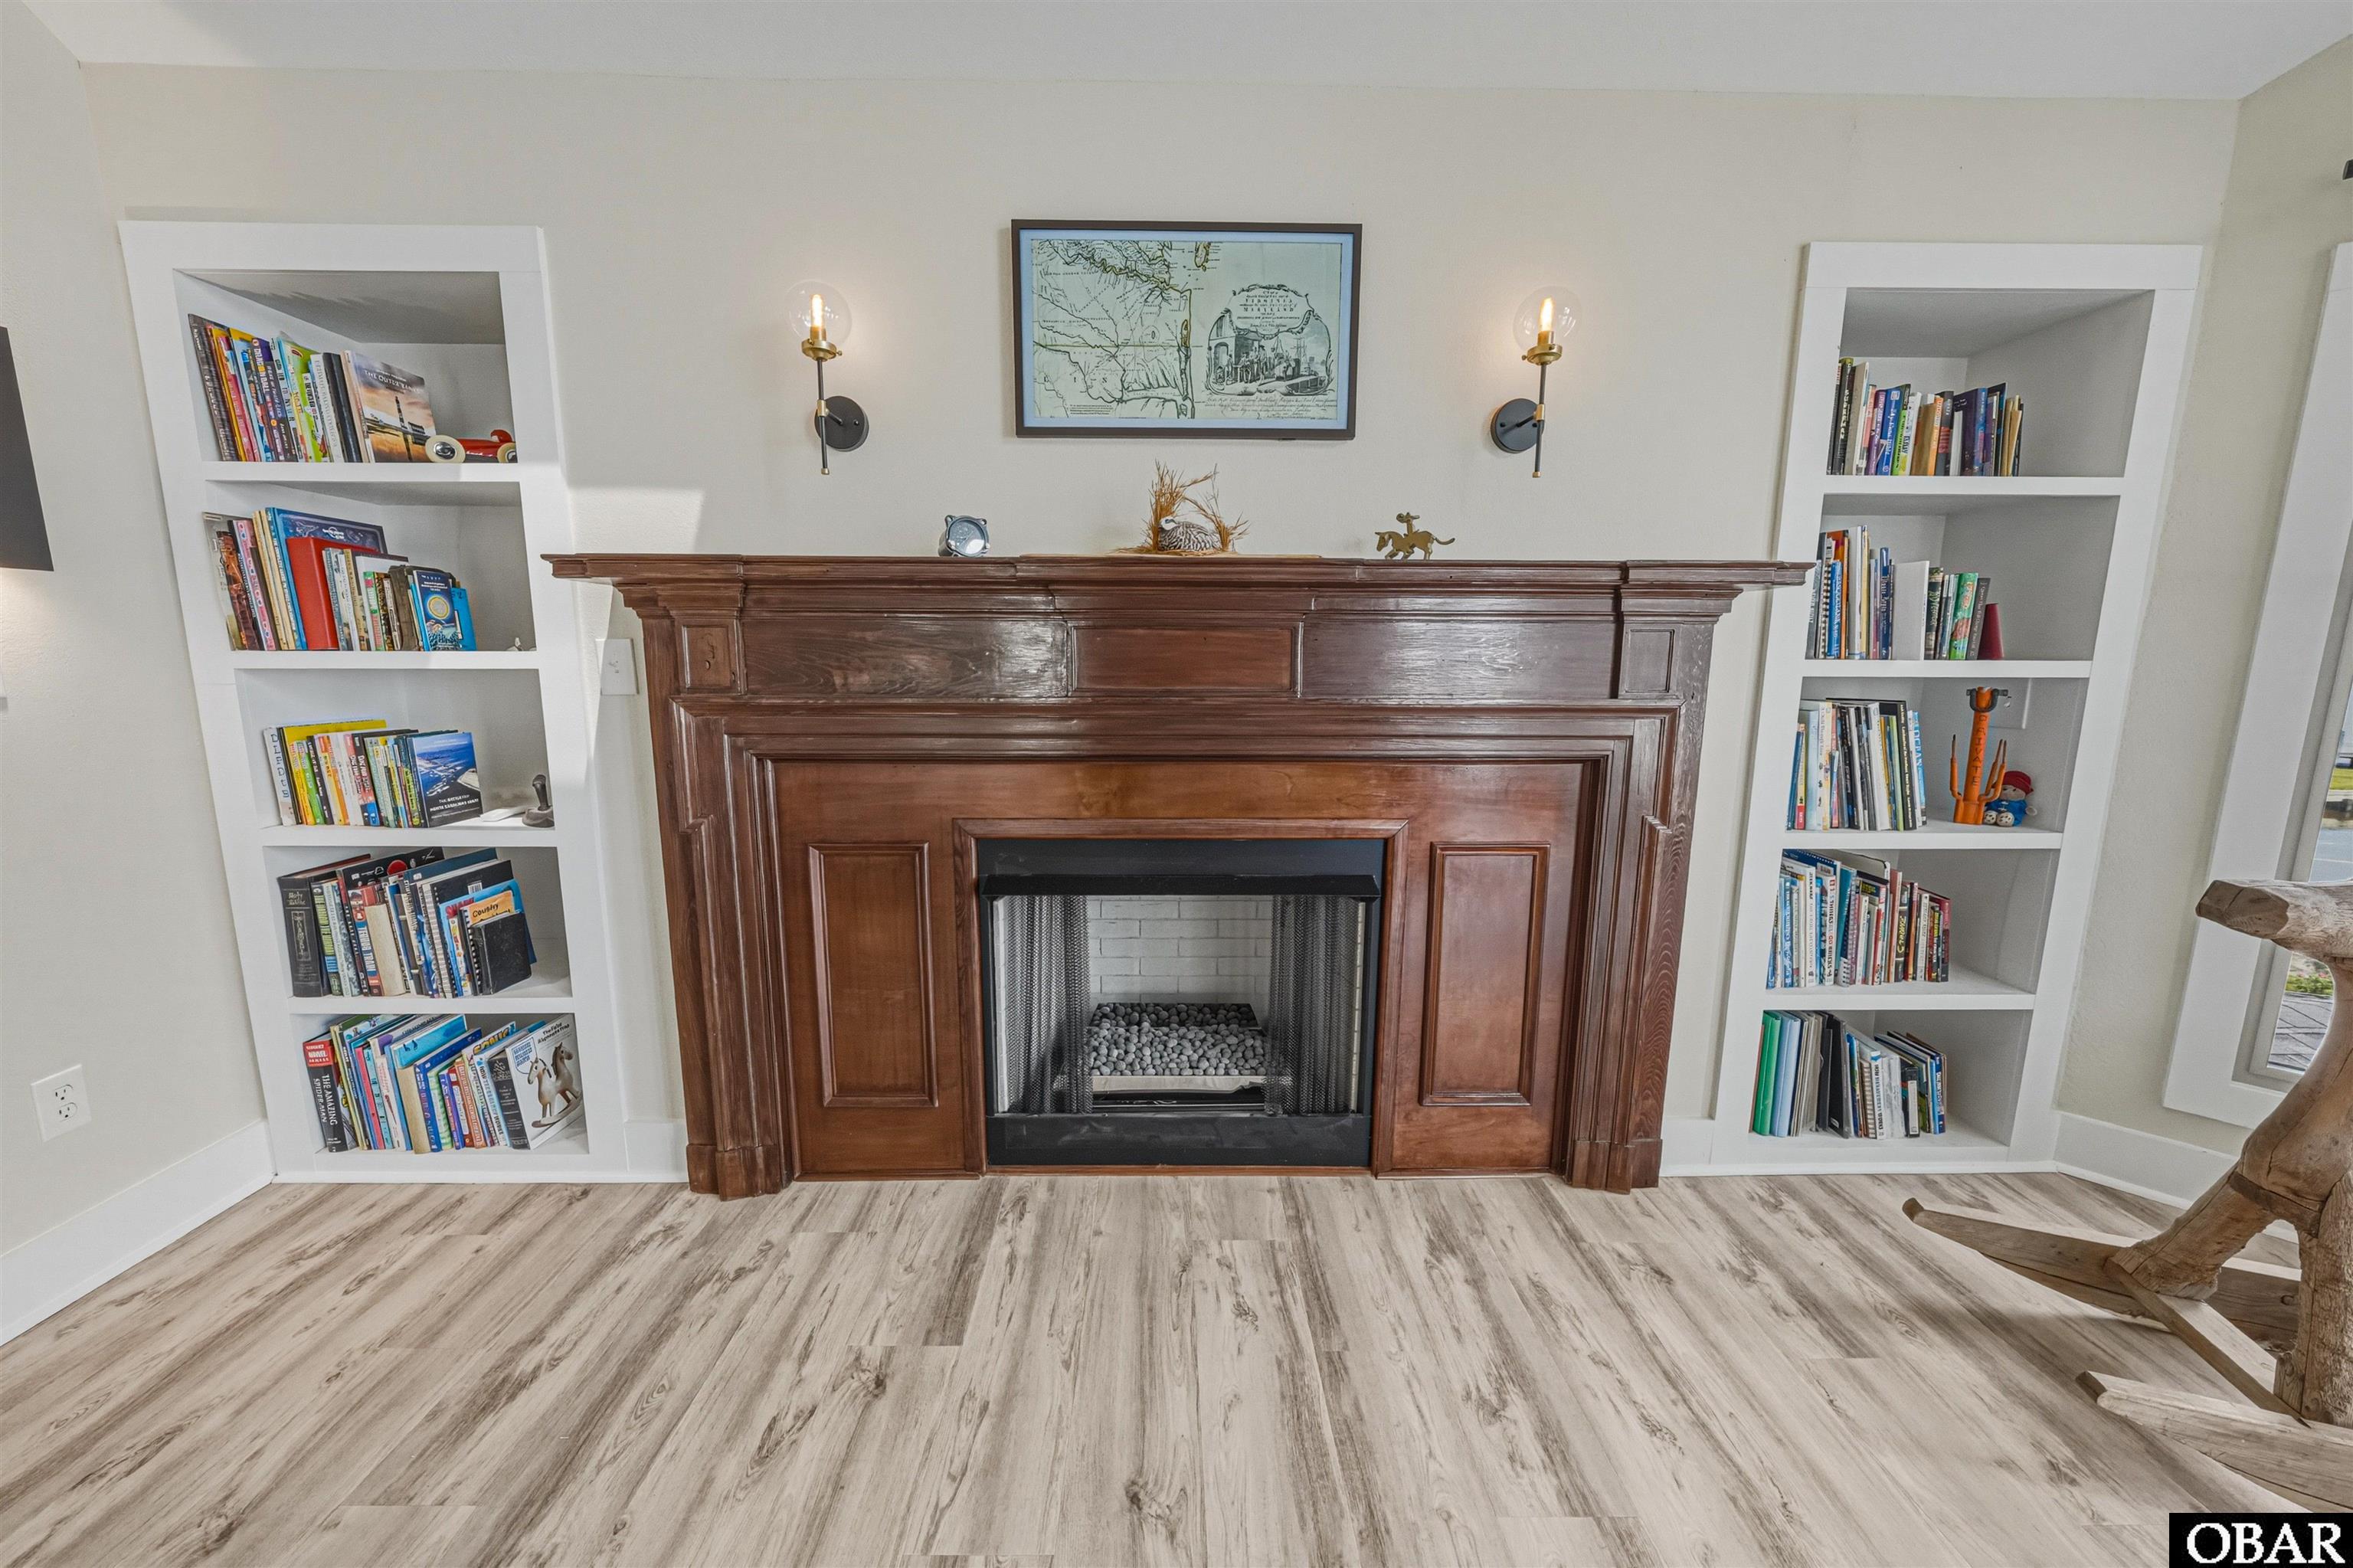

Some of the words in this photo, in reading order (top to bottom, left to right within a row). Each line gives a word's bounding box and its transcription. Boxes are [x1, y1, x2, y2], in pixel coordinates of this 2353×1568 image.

[1913, 729, 1923, 767] OCEAN
[1973, 715, 1986, 787] PRIVATE
[322, 1073, 331, 1088] THE
[325, 1089, 338, 1125] AMAZING
